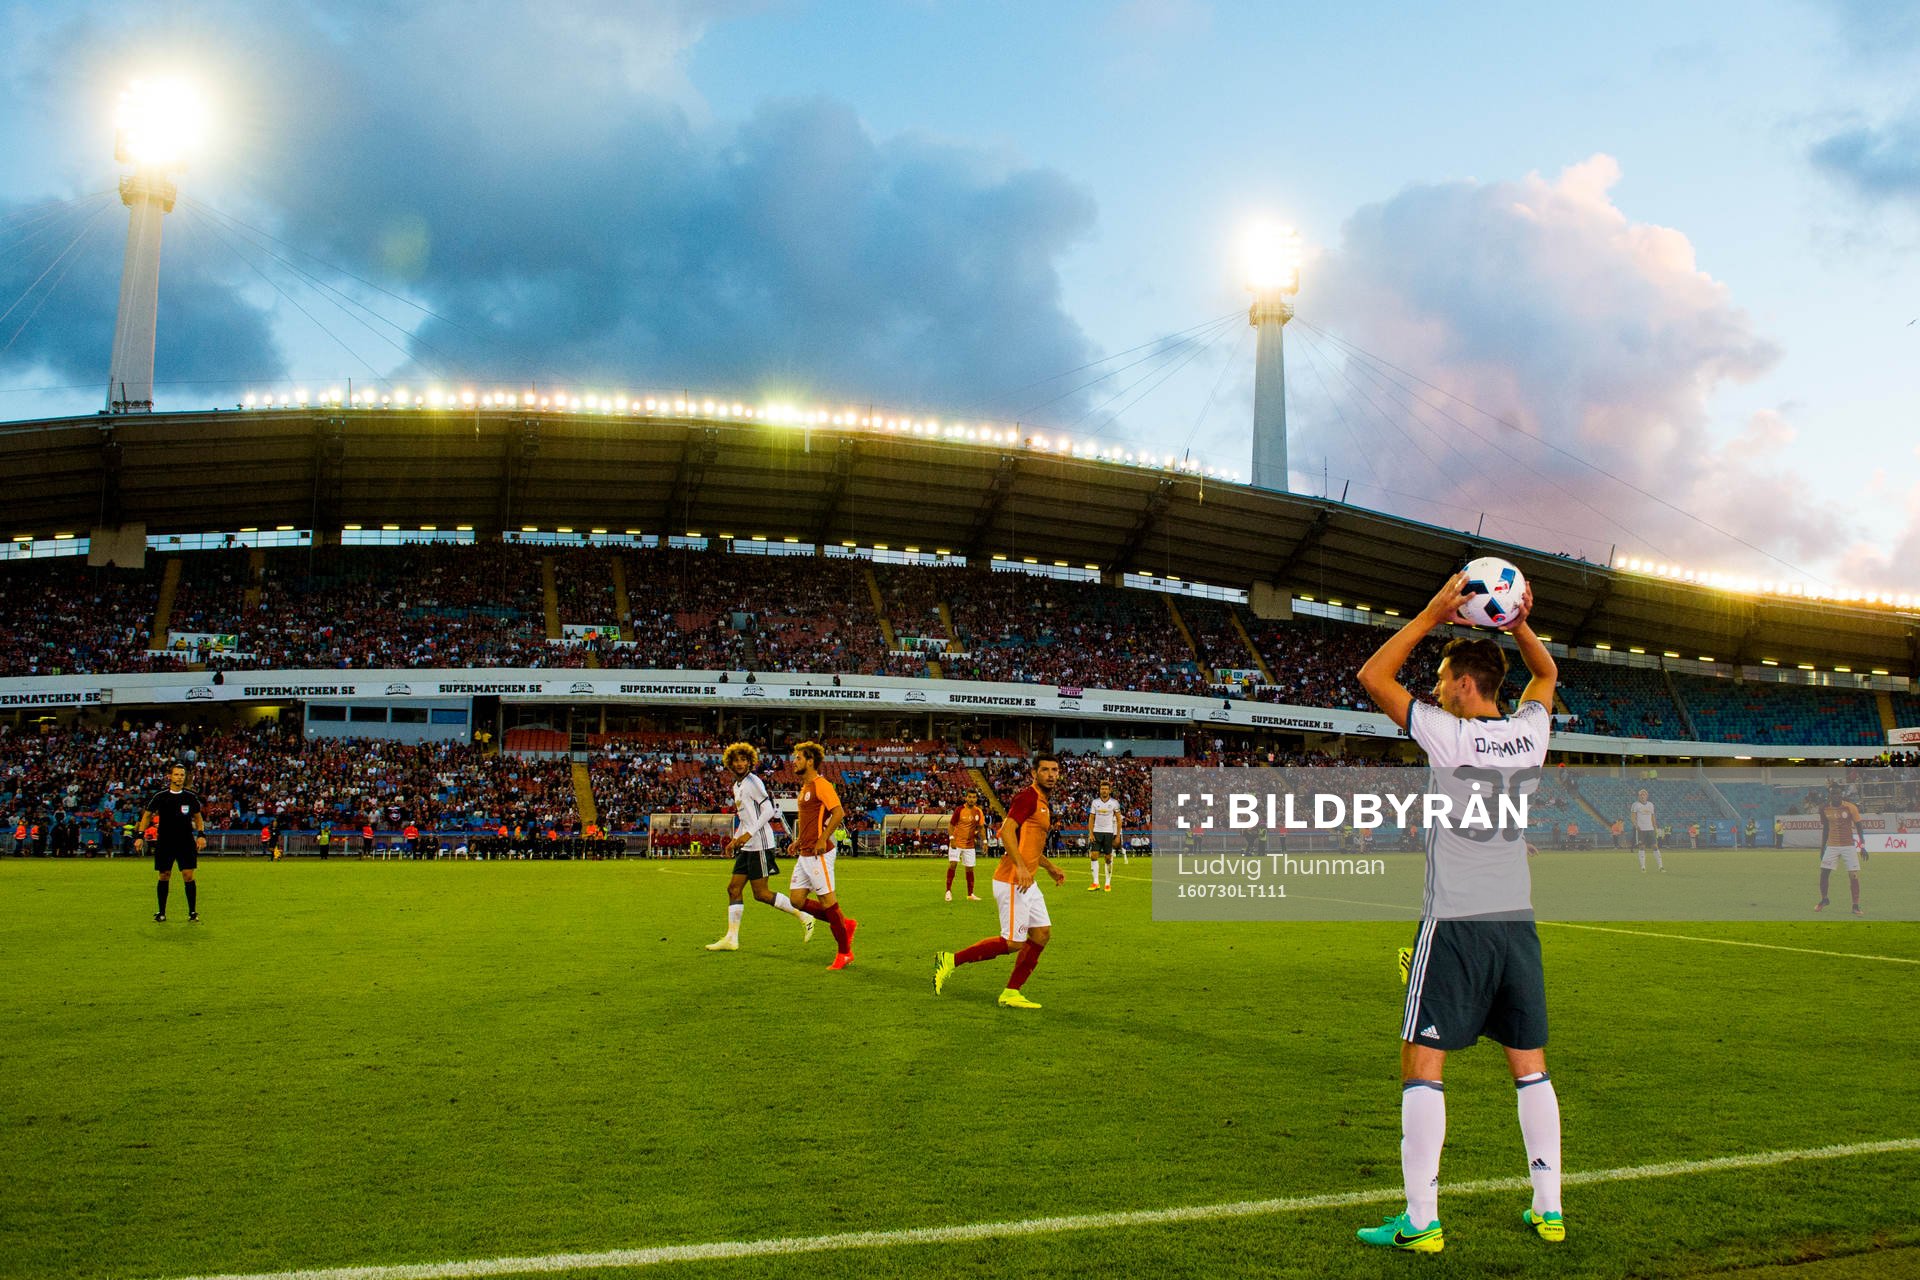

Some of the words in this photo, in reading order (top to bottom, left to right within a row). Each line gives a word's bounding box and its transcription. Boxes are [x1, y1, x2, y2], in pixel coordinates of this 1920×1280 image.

[243, 686, 356, 696] SUPERMATCHEN.SE
[438, 684, 542, 693] SUPERMATCHEN.SE
[620, 684, 717, 695] SUPERMATCHEN.SE
[789, 688, 880, 699] SUPERMATCHEN.SE
[0, 693, 100, 705] ERMATCHEN.SE
[949, 694, 1036, 706] SUPERMATCHEN.SE
[1102, 703, 1186, 717] SUPERMATCHEN.SE
[1251, 715, 1333, 730] SUPERMATCHEN.SE
